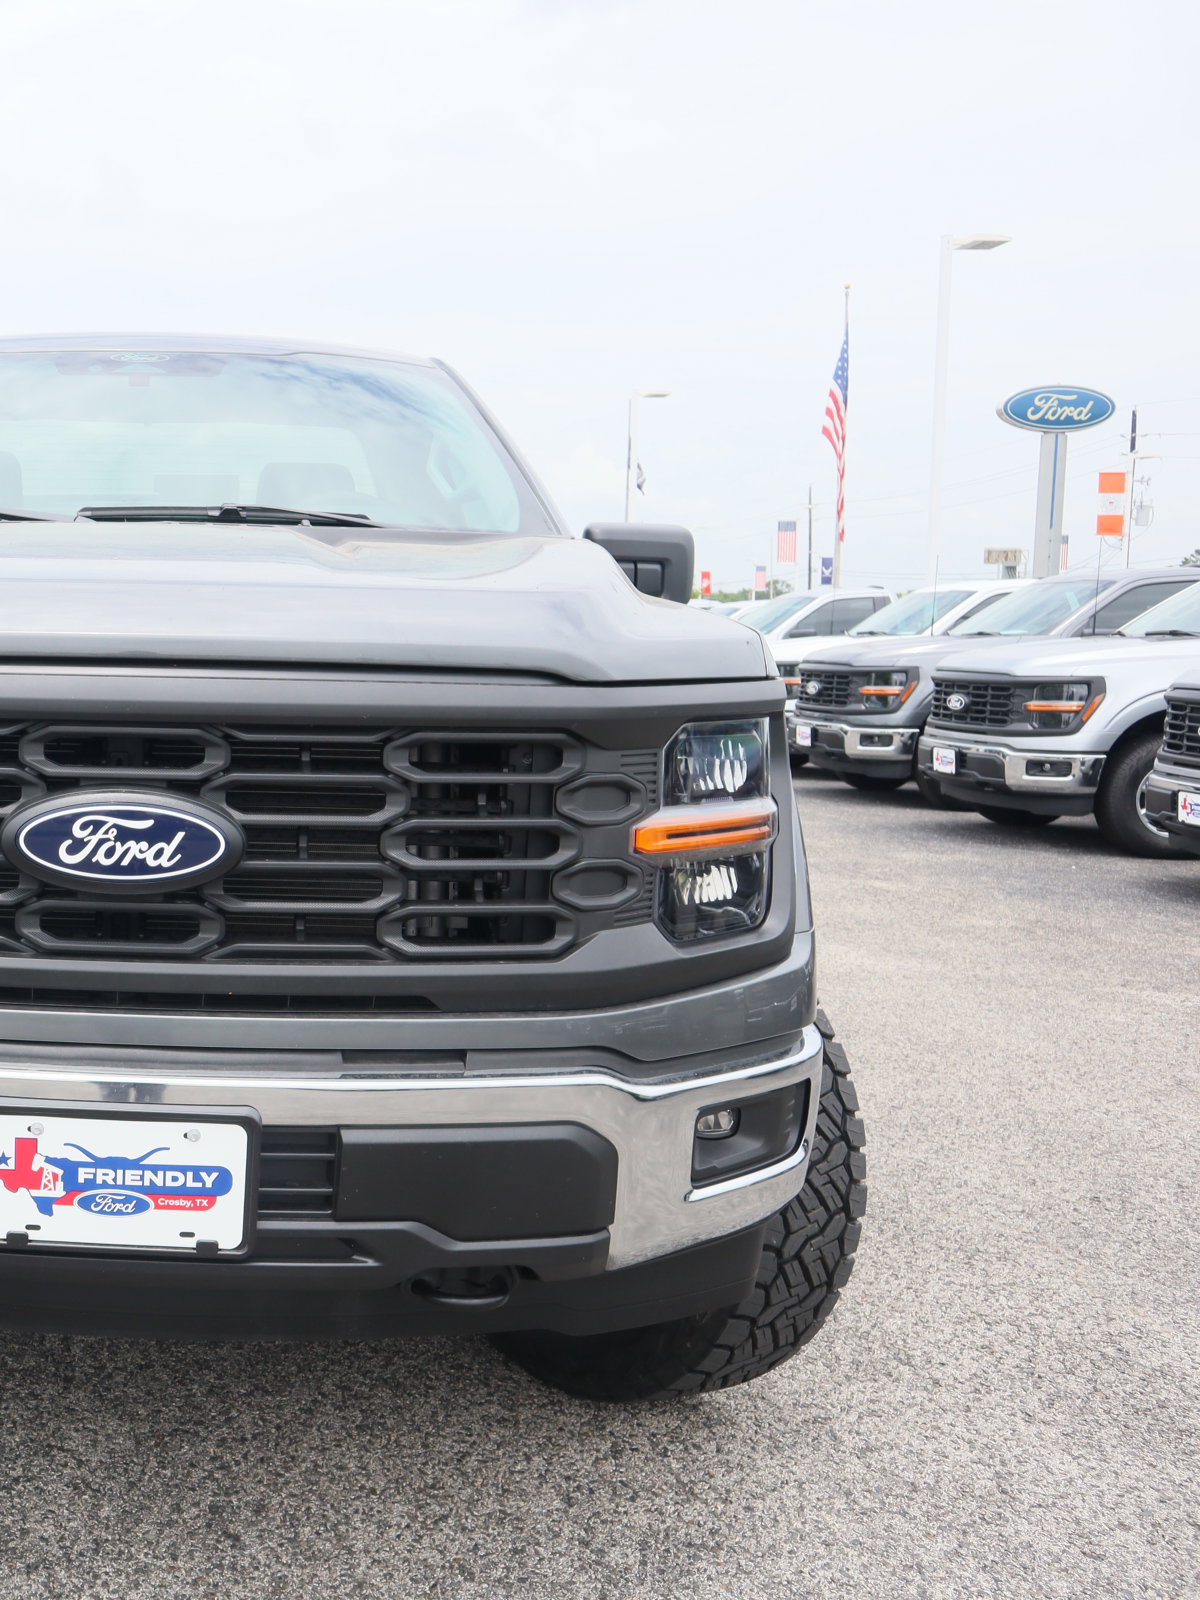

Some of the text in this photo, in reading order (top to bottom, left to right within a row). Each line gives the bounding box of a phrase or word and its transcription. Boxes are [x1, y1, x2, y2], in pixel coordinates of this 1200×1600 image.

[1026, 393, 1094, 421] Ford
[58, 815, 186, 868] Ford
[77, 1167, 219, 1188] FRIENDLY
[90, 1193, 137, 1213] Ford
[157, 1197, 209, 1207] Crosby, TX
